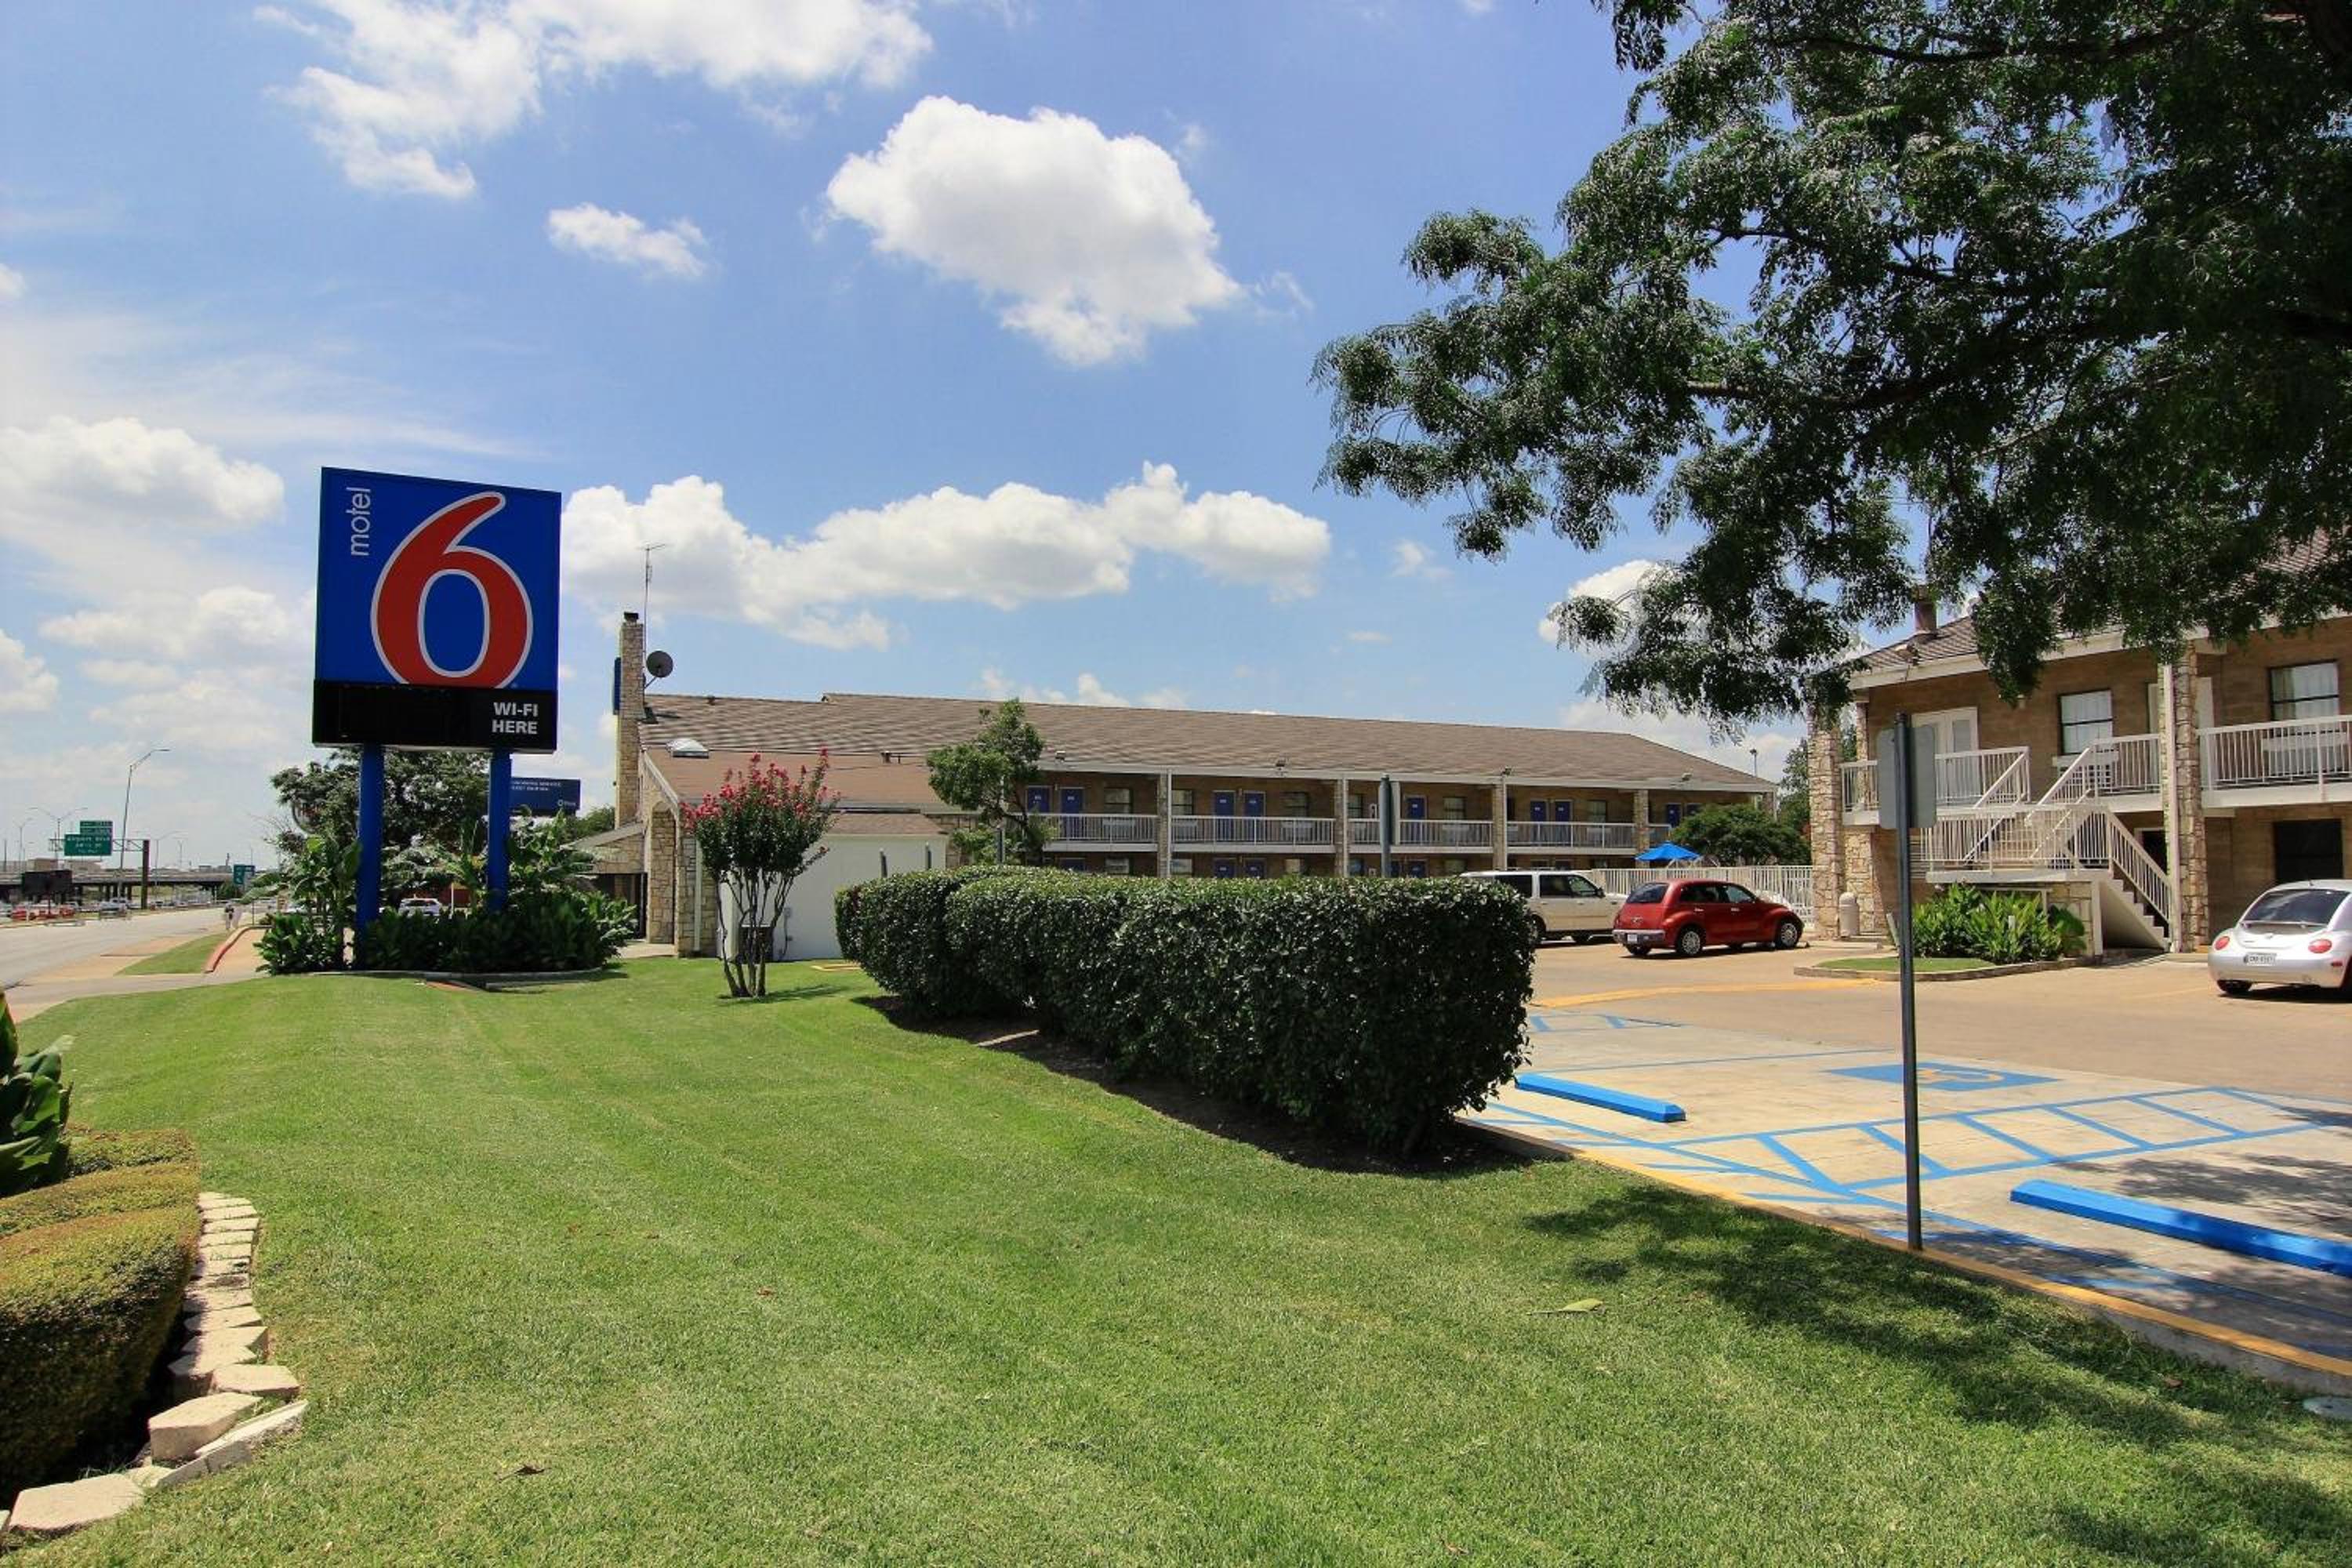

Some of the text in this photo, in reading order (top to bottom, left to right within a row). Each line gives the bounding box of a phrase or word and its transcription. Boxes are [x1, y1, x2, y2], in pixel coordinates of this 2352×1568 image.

[346, 486, 535, 688] motel 6
[492, 702, 539, 717] WI-FI
[491, 720, 539, 735] HERE
